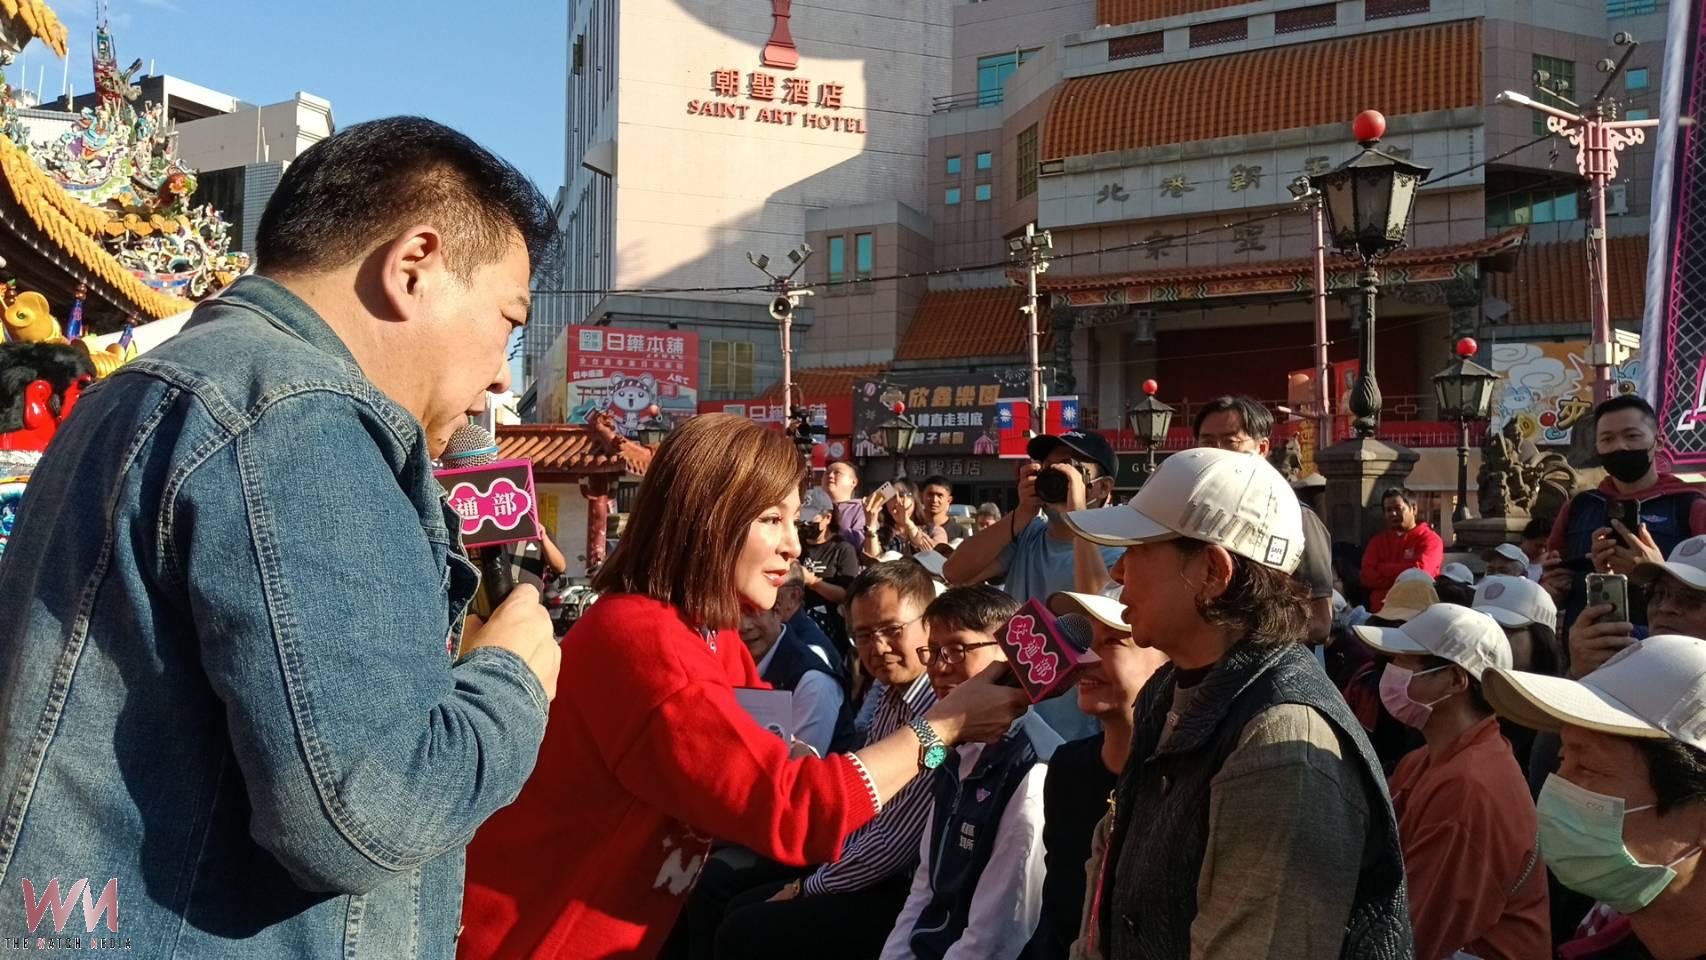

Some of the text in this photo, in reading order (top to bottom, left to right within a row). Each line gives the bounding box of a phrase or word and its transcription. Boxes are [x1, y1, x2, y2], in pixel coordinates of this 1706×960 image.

[711, 67, 843, 110] 朝聖酒店
[687, 99, 866, 134] SAINT ART HOTEL
[911, 459, 981, 476] 朝聖酒店
[1012, 623, 1053, 678] 交通部
